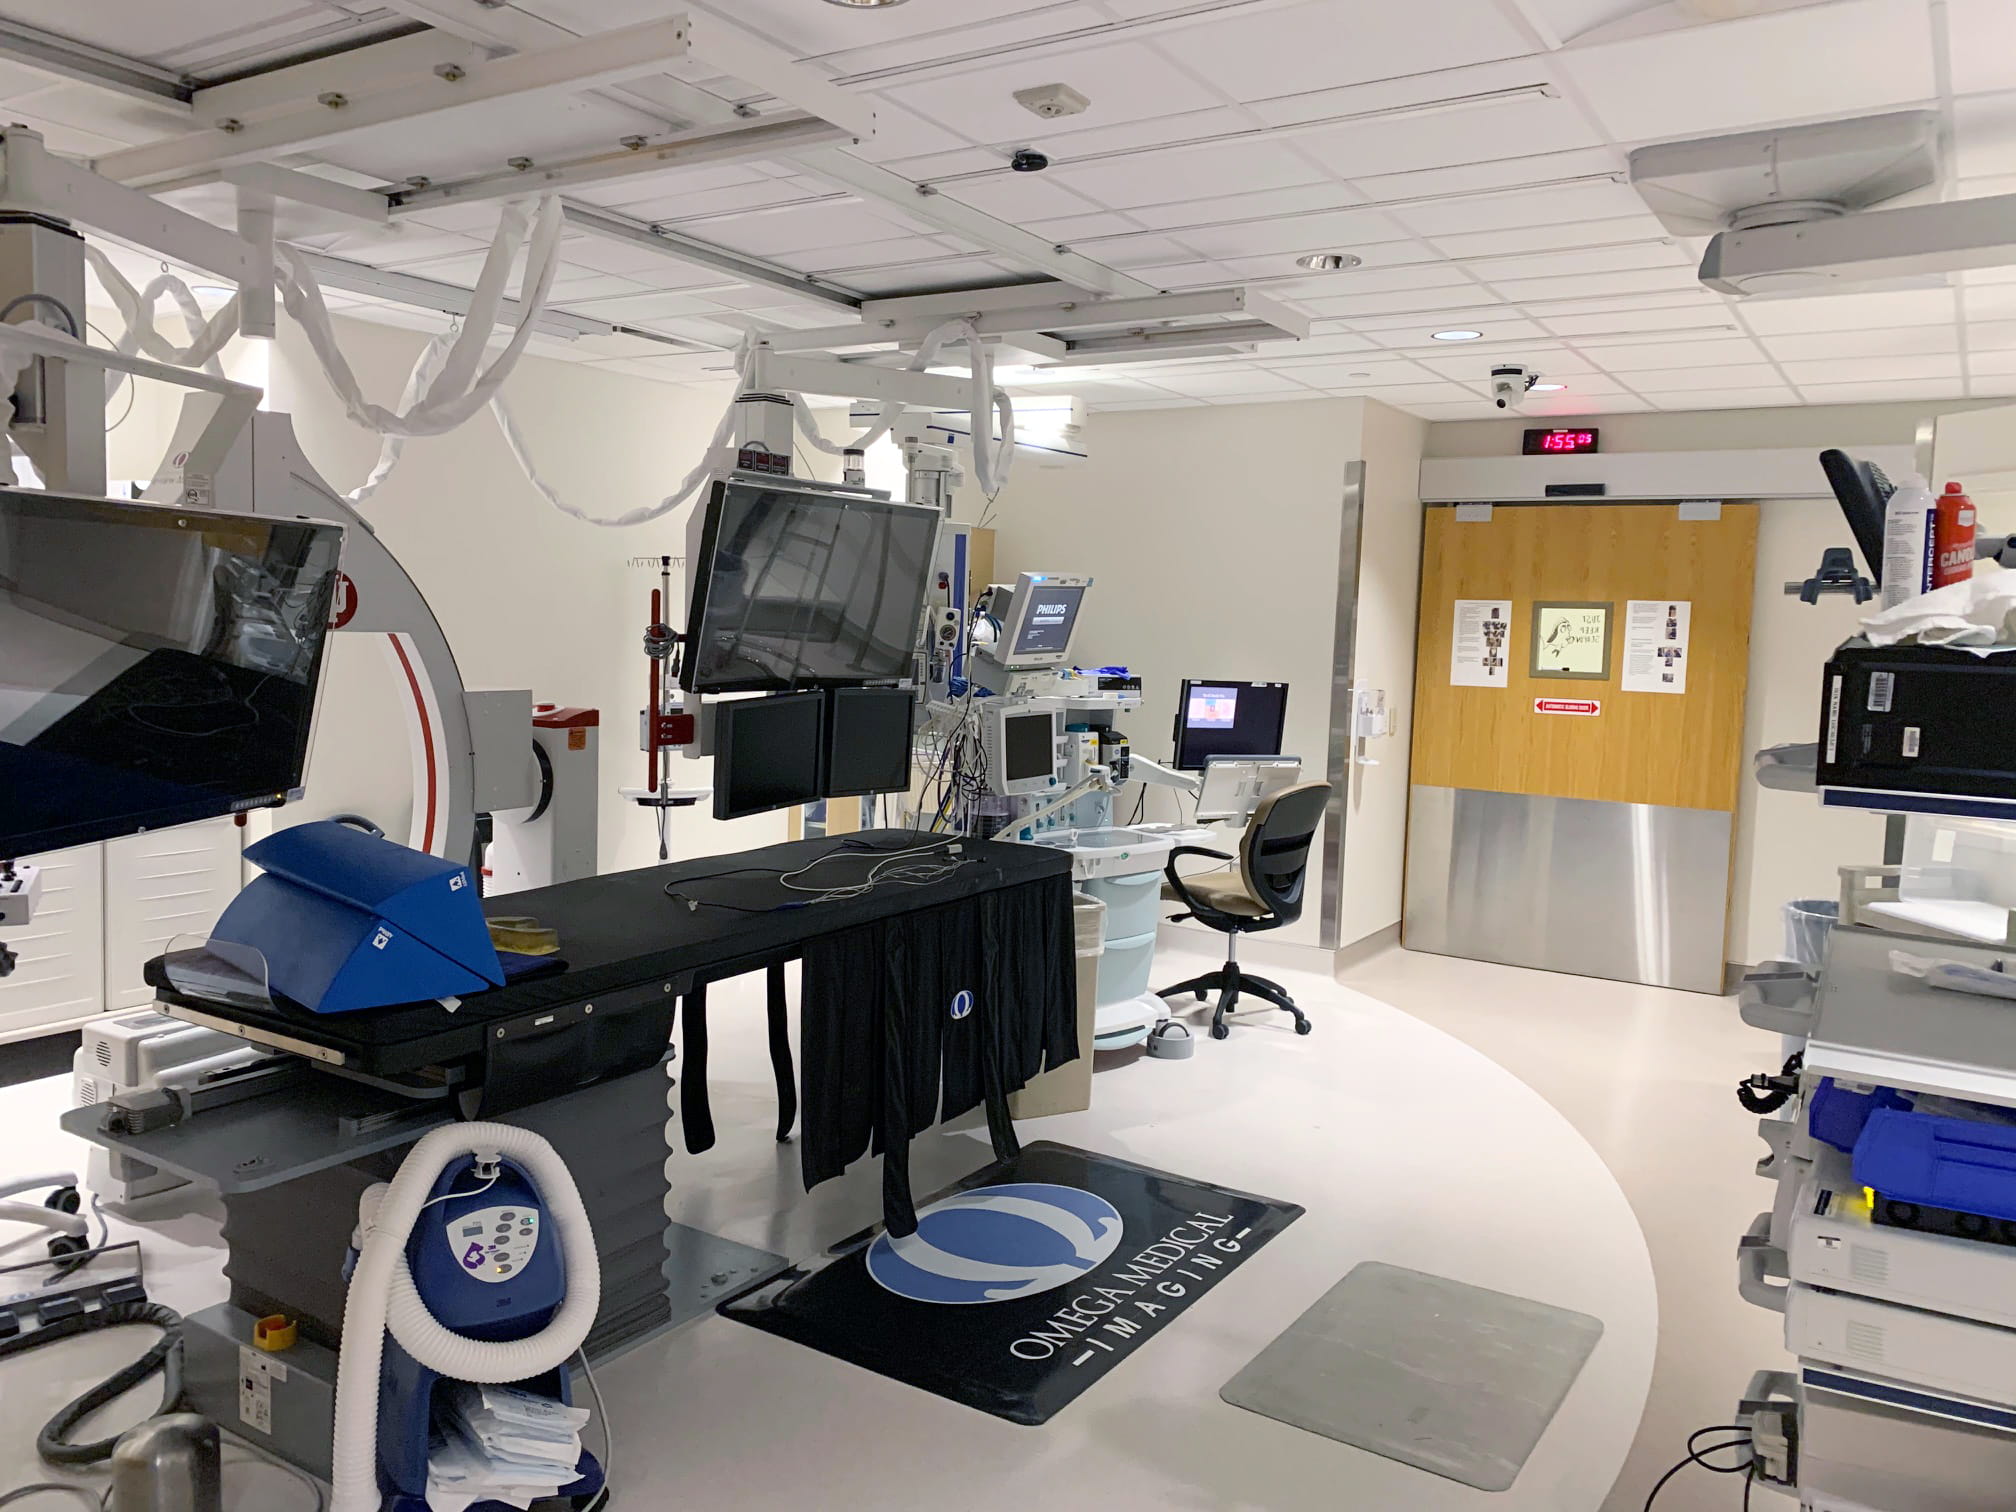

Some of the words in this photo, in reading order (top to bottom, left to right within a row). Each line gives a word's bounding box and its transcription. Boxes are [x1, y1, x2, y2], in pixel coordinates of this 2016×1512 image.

[1544, 434, 1575, 449] 1:55
[1926, 523, 1936, 593] NTERCEPT
[1036, 604, 1067, 615] PHILIPS
[1009, 1286, 1137, 1360] OMEGA
[1112, 1211, 1235, 1287] MEDICAL
